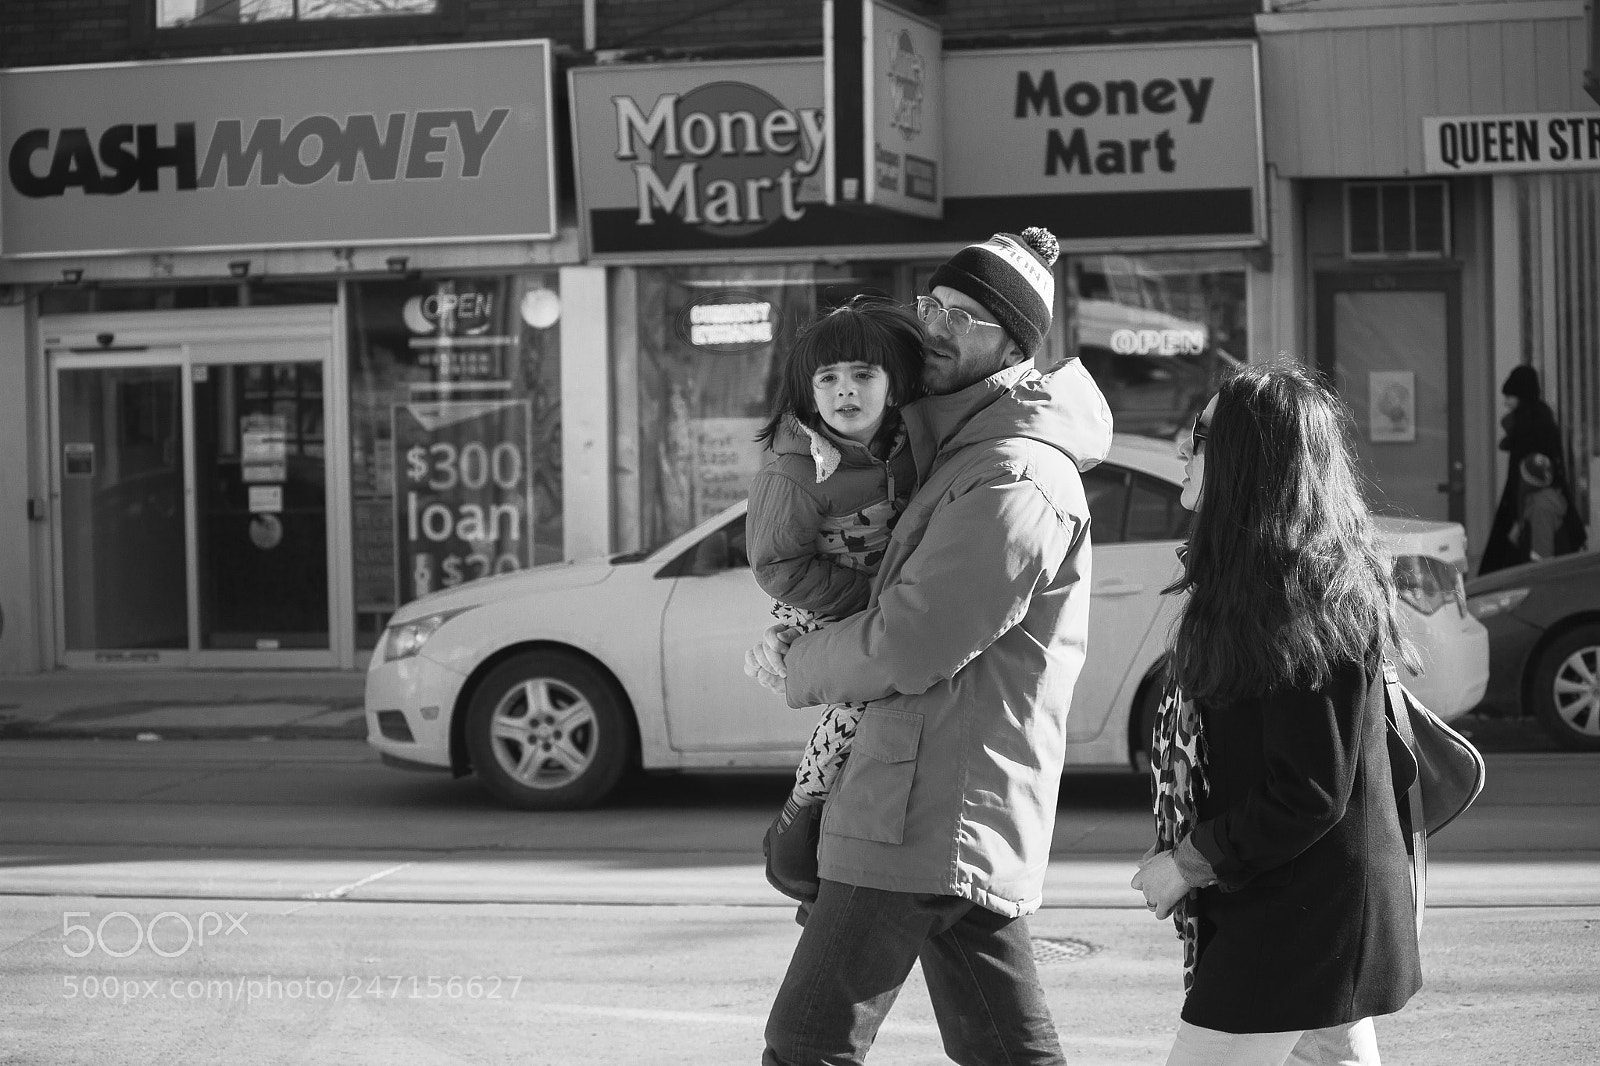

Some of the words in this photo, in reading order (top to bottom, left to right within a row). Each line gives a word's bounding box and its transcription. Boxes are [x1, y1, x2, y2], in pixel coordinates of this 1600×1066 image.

[1014, 69, 1214, 124] Money
[8, 122, 198, 198] CASH
[198, 108, 510, 189] MONEY
[611, 93, 826, 175] Money
[1044, 127, 1176, 176] Mart
[1439, 119, 1541, 169] QUEEN
[632, 162, 806, 226] Mart
[423, 292, 493, 319] OPEN
[1110, 328, 1206, 356] OPEN
[407, 441, 522, 491] $300
[408, 491, 520, 542] loan
